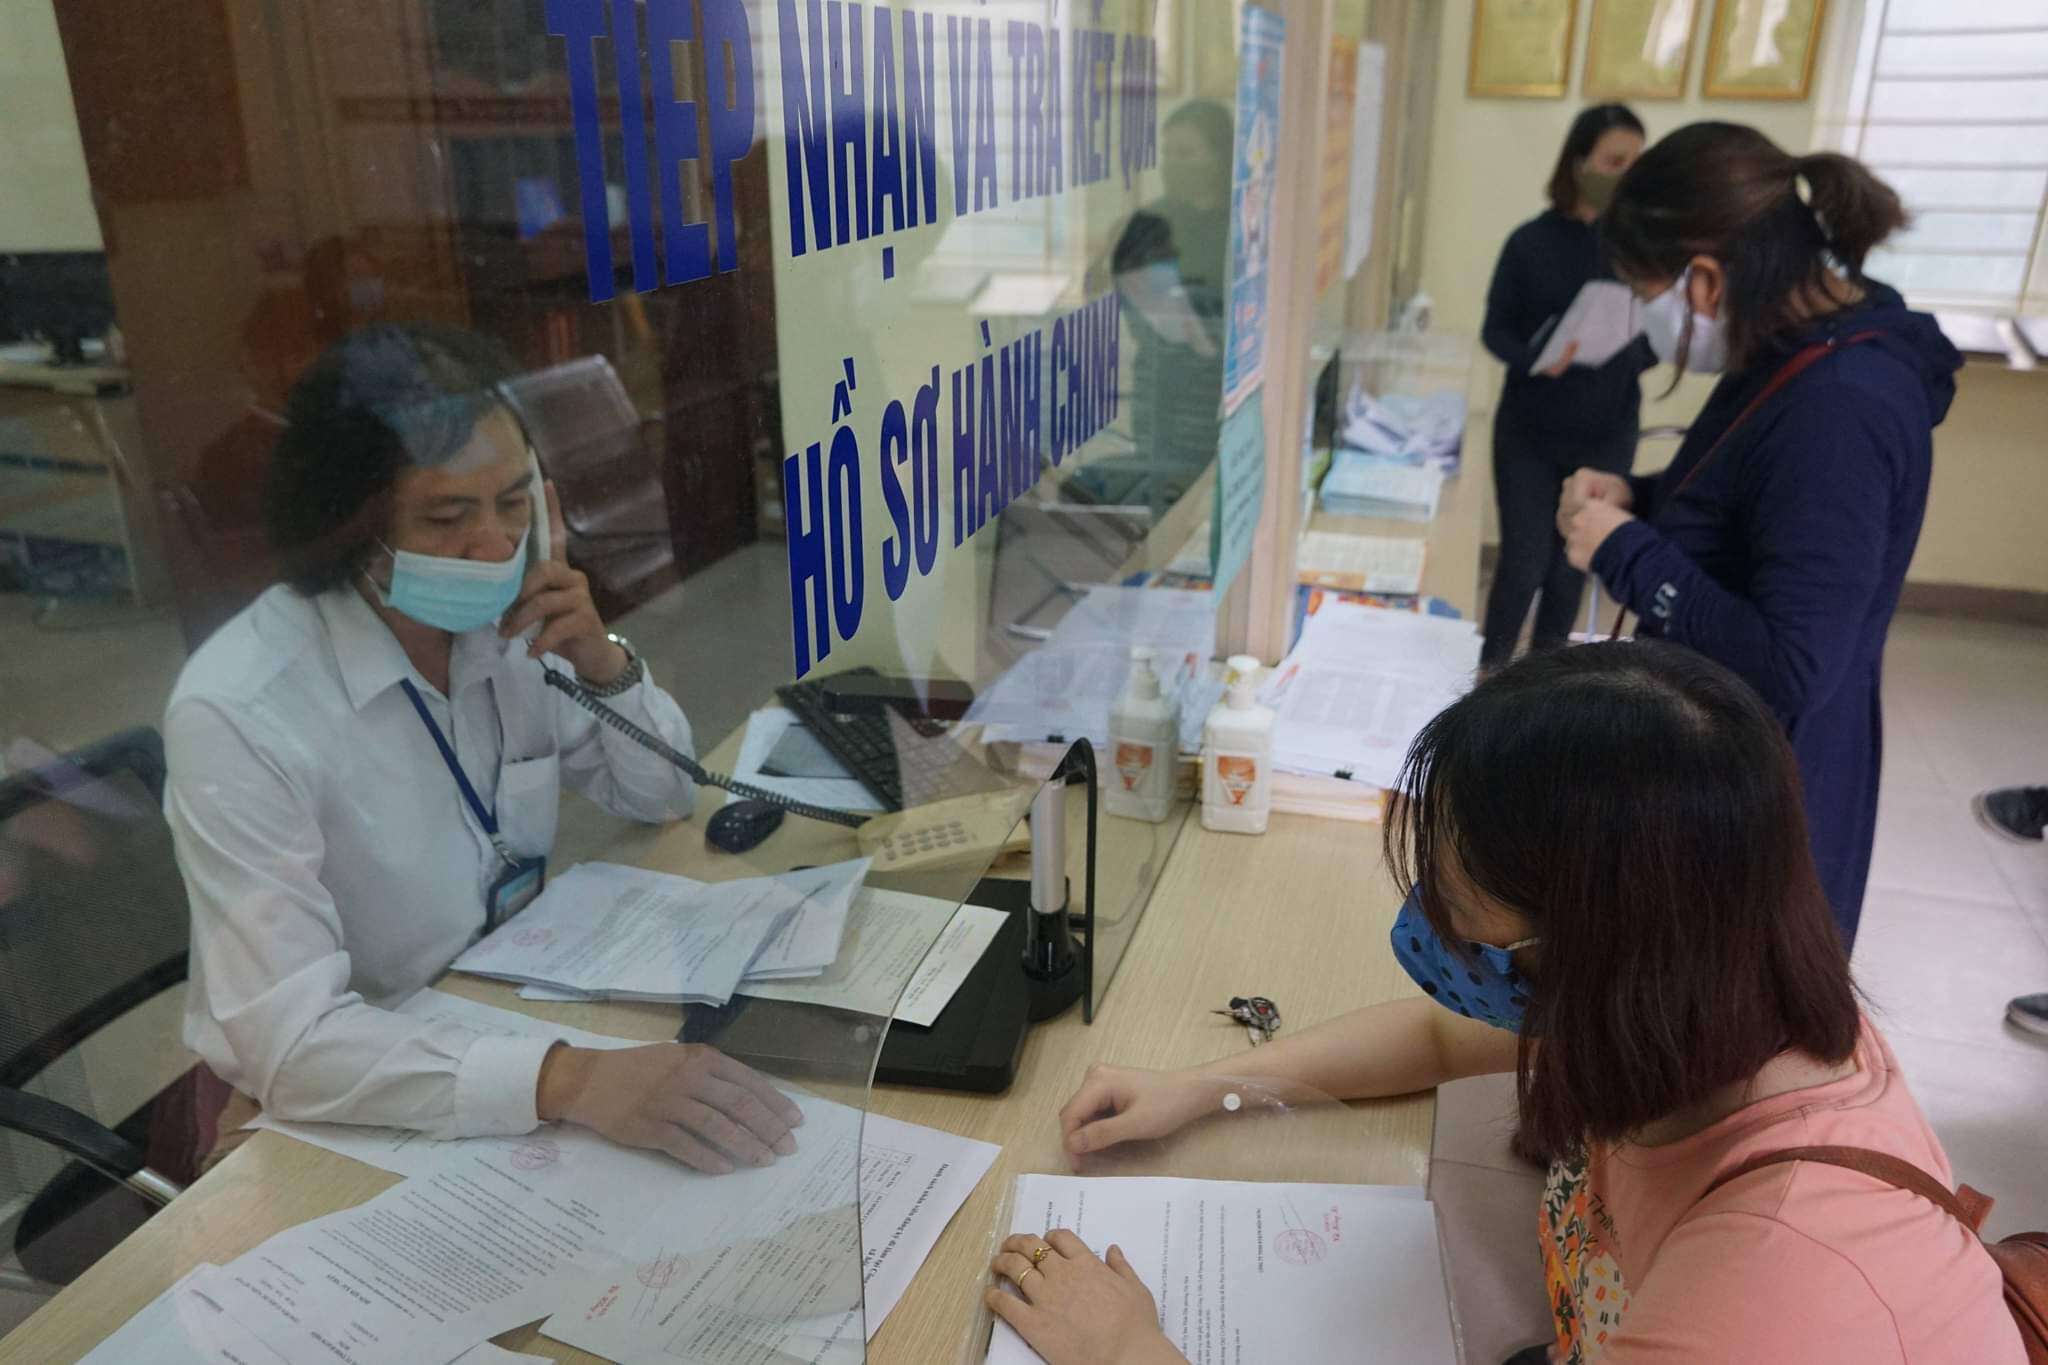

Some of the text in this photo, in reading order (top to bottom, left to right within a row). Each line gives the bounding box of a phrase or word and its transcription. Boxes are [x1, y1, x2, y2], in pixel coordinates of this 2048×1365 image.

[776, 0, 937, 281] NHẠN
[784, 356, 864, 681] HỒ
[880, 364, 940, 601] SƠ
[952, 319, 1042, 549] HÀNH
